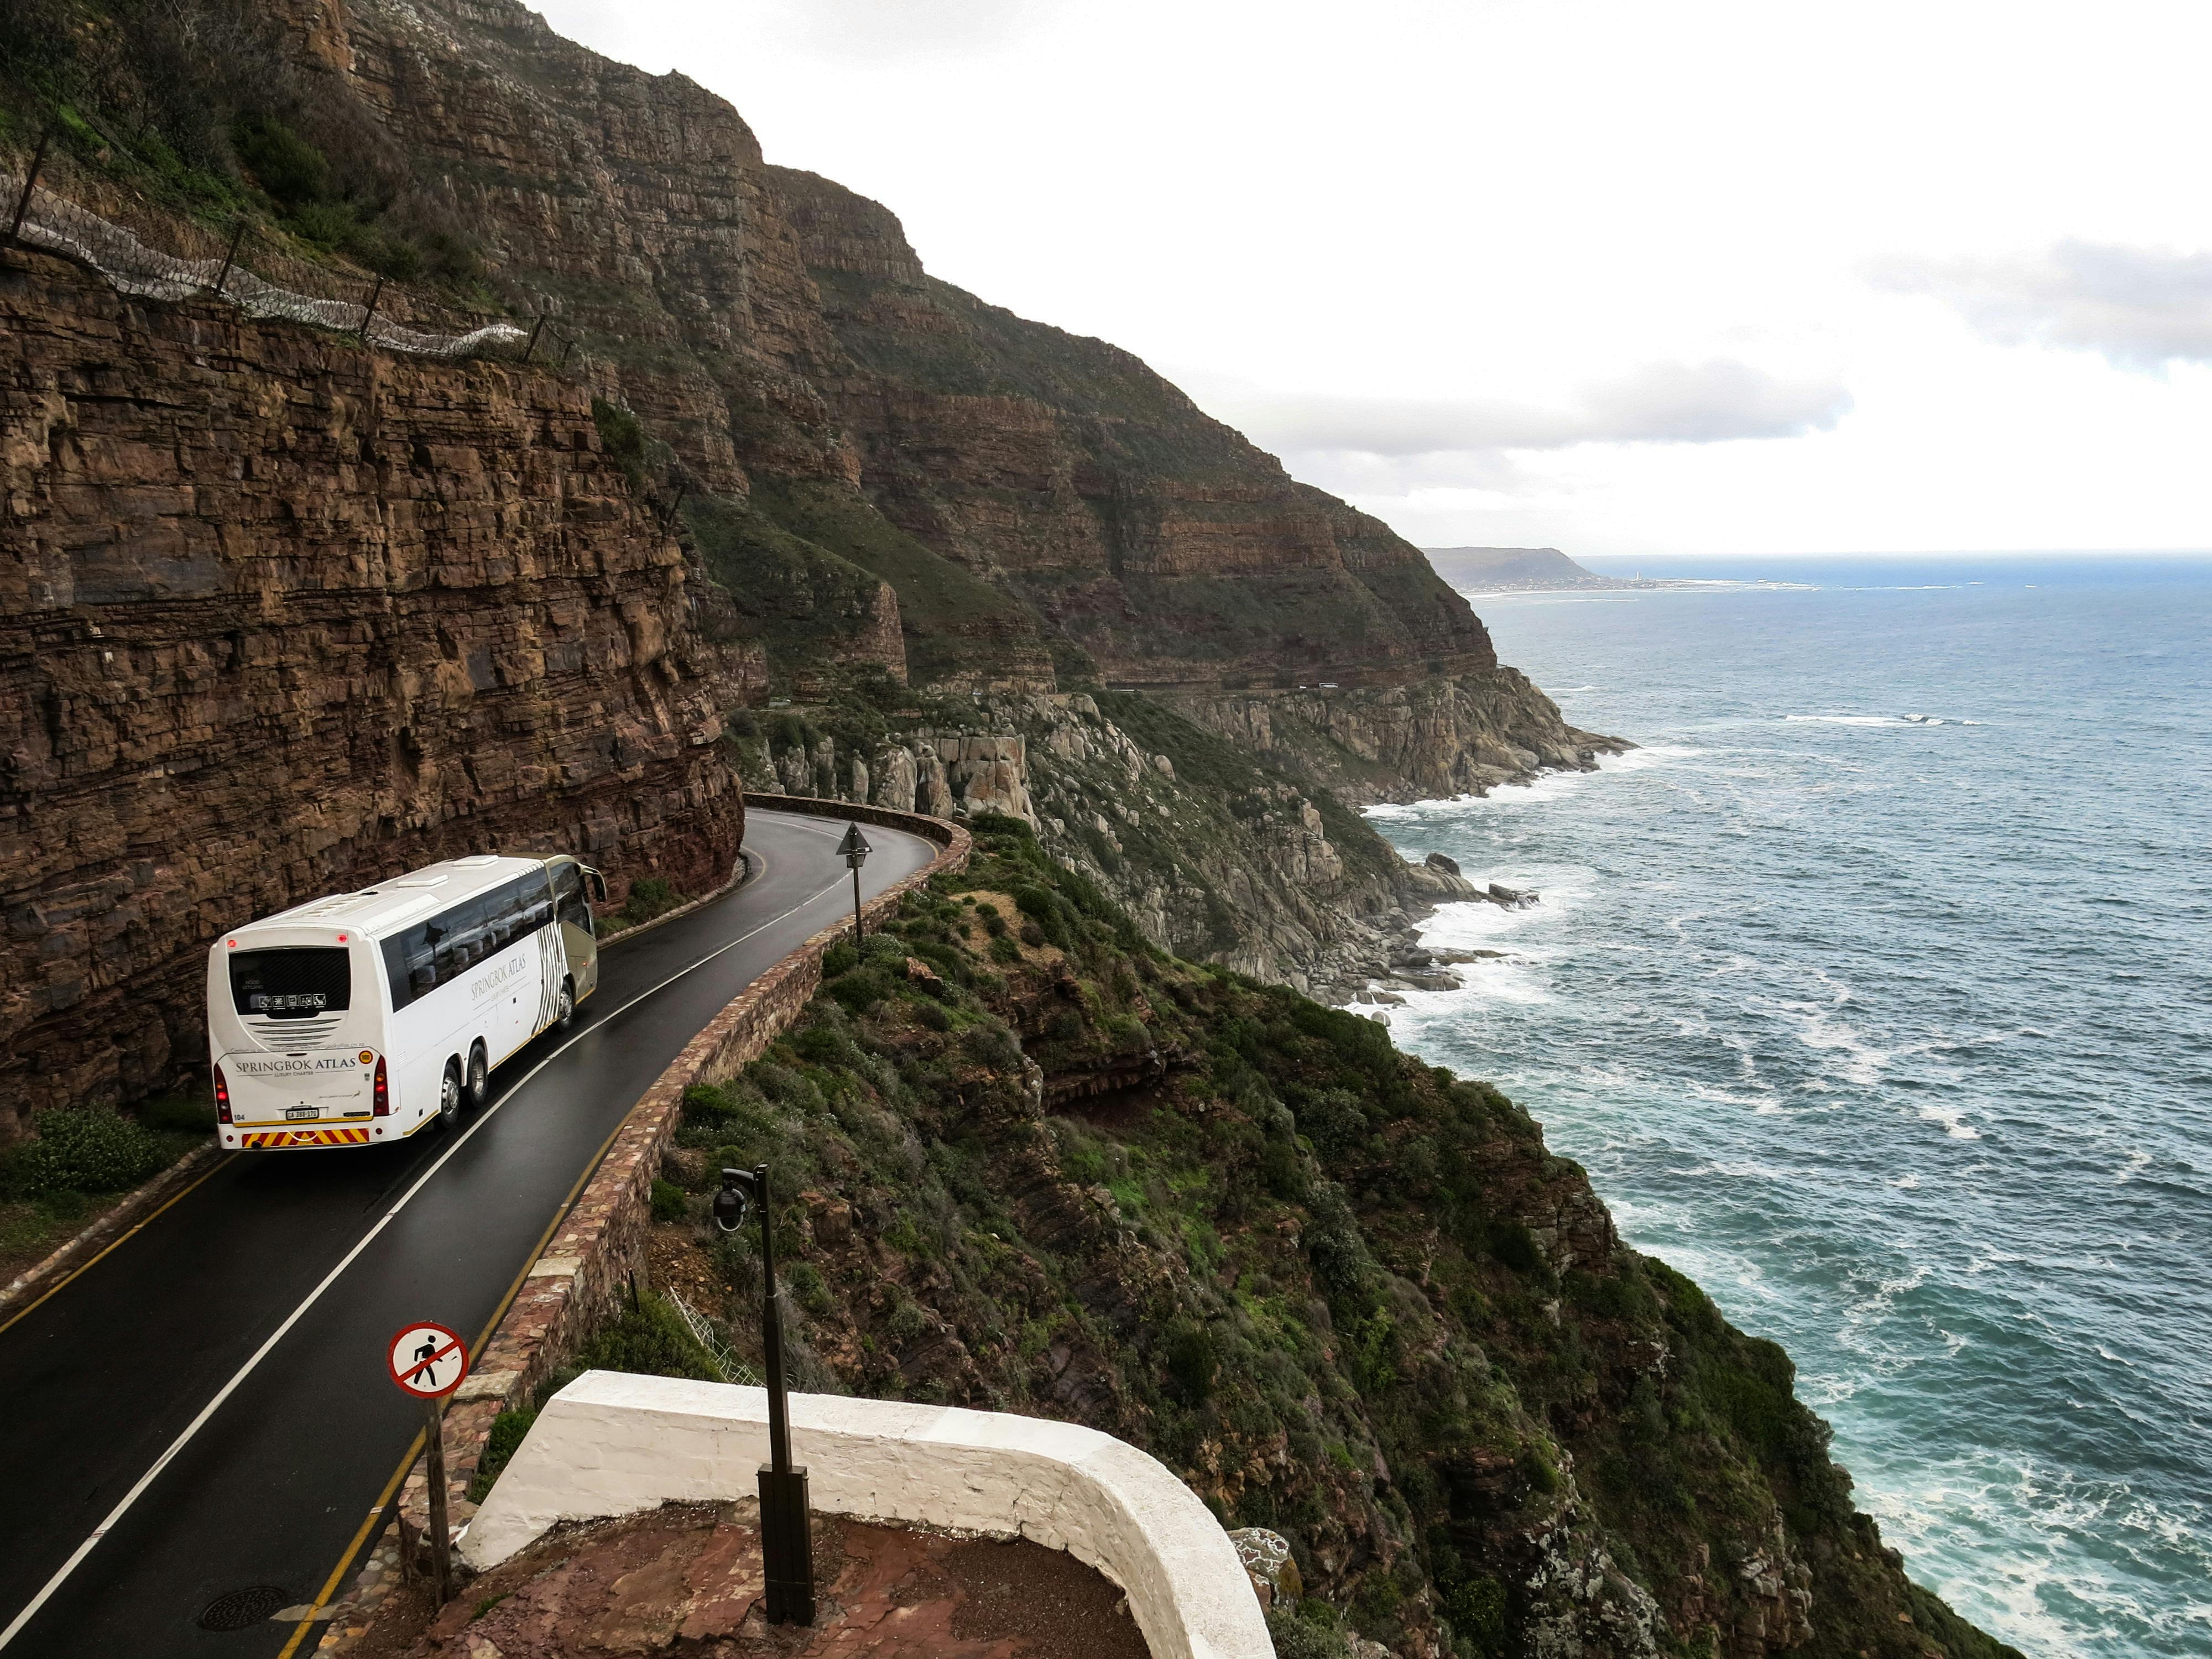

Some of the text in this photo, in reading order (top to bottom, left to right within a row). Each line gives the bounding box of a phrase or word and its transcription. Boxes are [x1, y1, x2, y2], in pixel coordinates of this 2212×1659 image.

[471, 964, 508, 1001] SPRINGBOK
[508, 953, 526, 978] ATLAS
[236, 1057, 356, 1073] SPRINGBOK ATLAS
